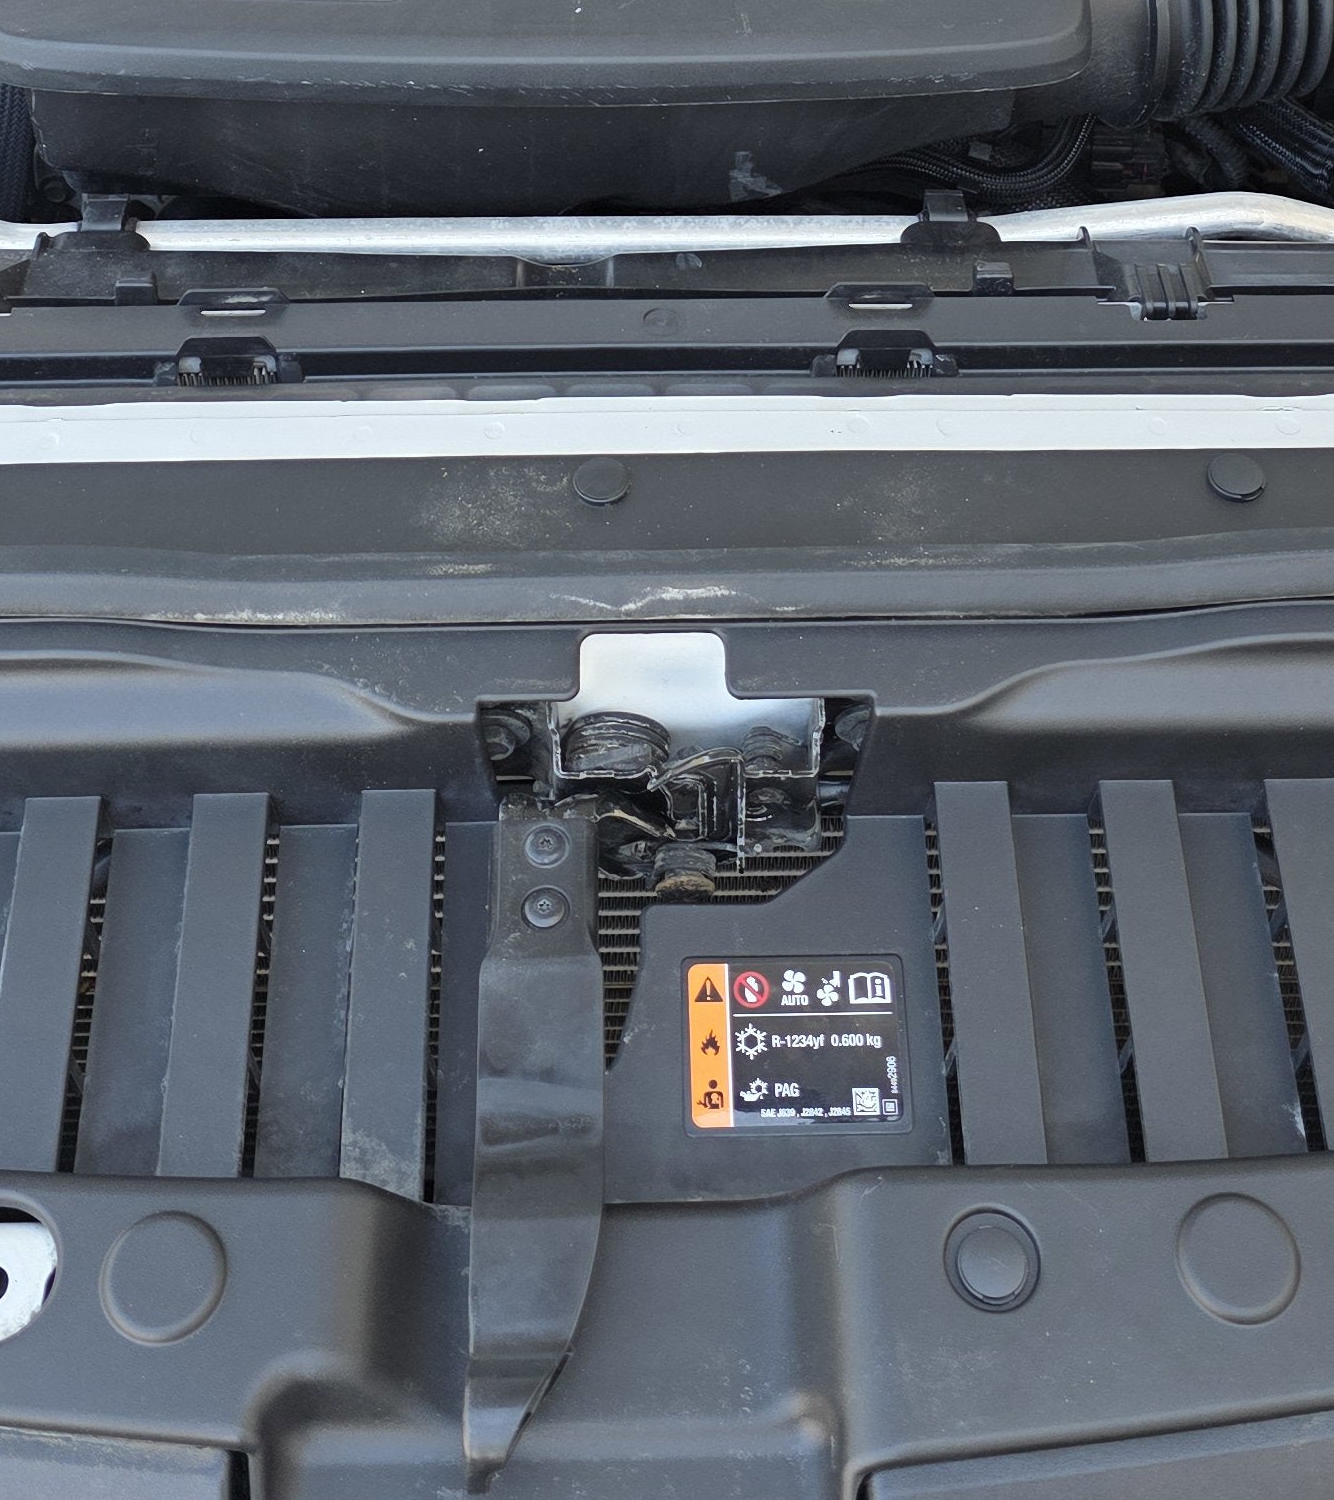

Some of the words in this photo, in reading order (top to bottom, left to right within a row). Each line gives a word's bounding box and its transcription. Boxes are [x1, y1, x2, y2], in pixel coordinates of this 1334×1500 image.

[781, 995, 809, 1005] AUTO
[771, 1034, 825, 1049] R-1234yf
[831, 1034, 864, 1047] 0.600
[866, 1034, 882, 1048] kg
[775, 1083, 800, 1097] PAG
